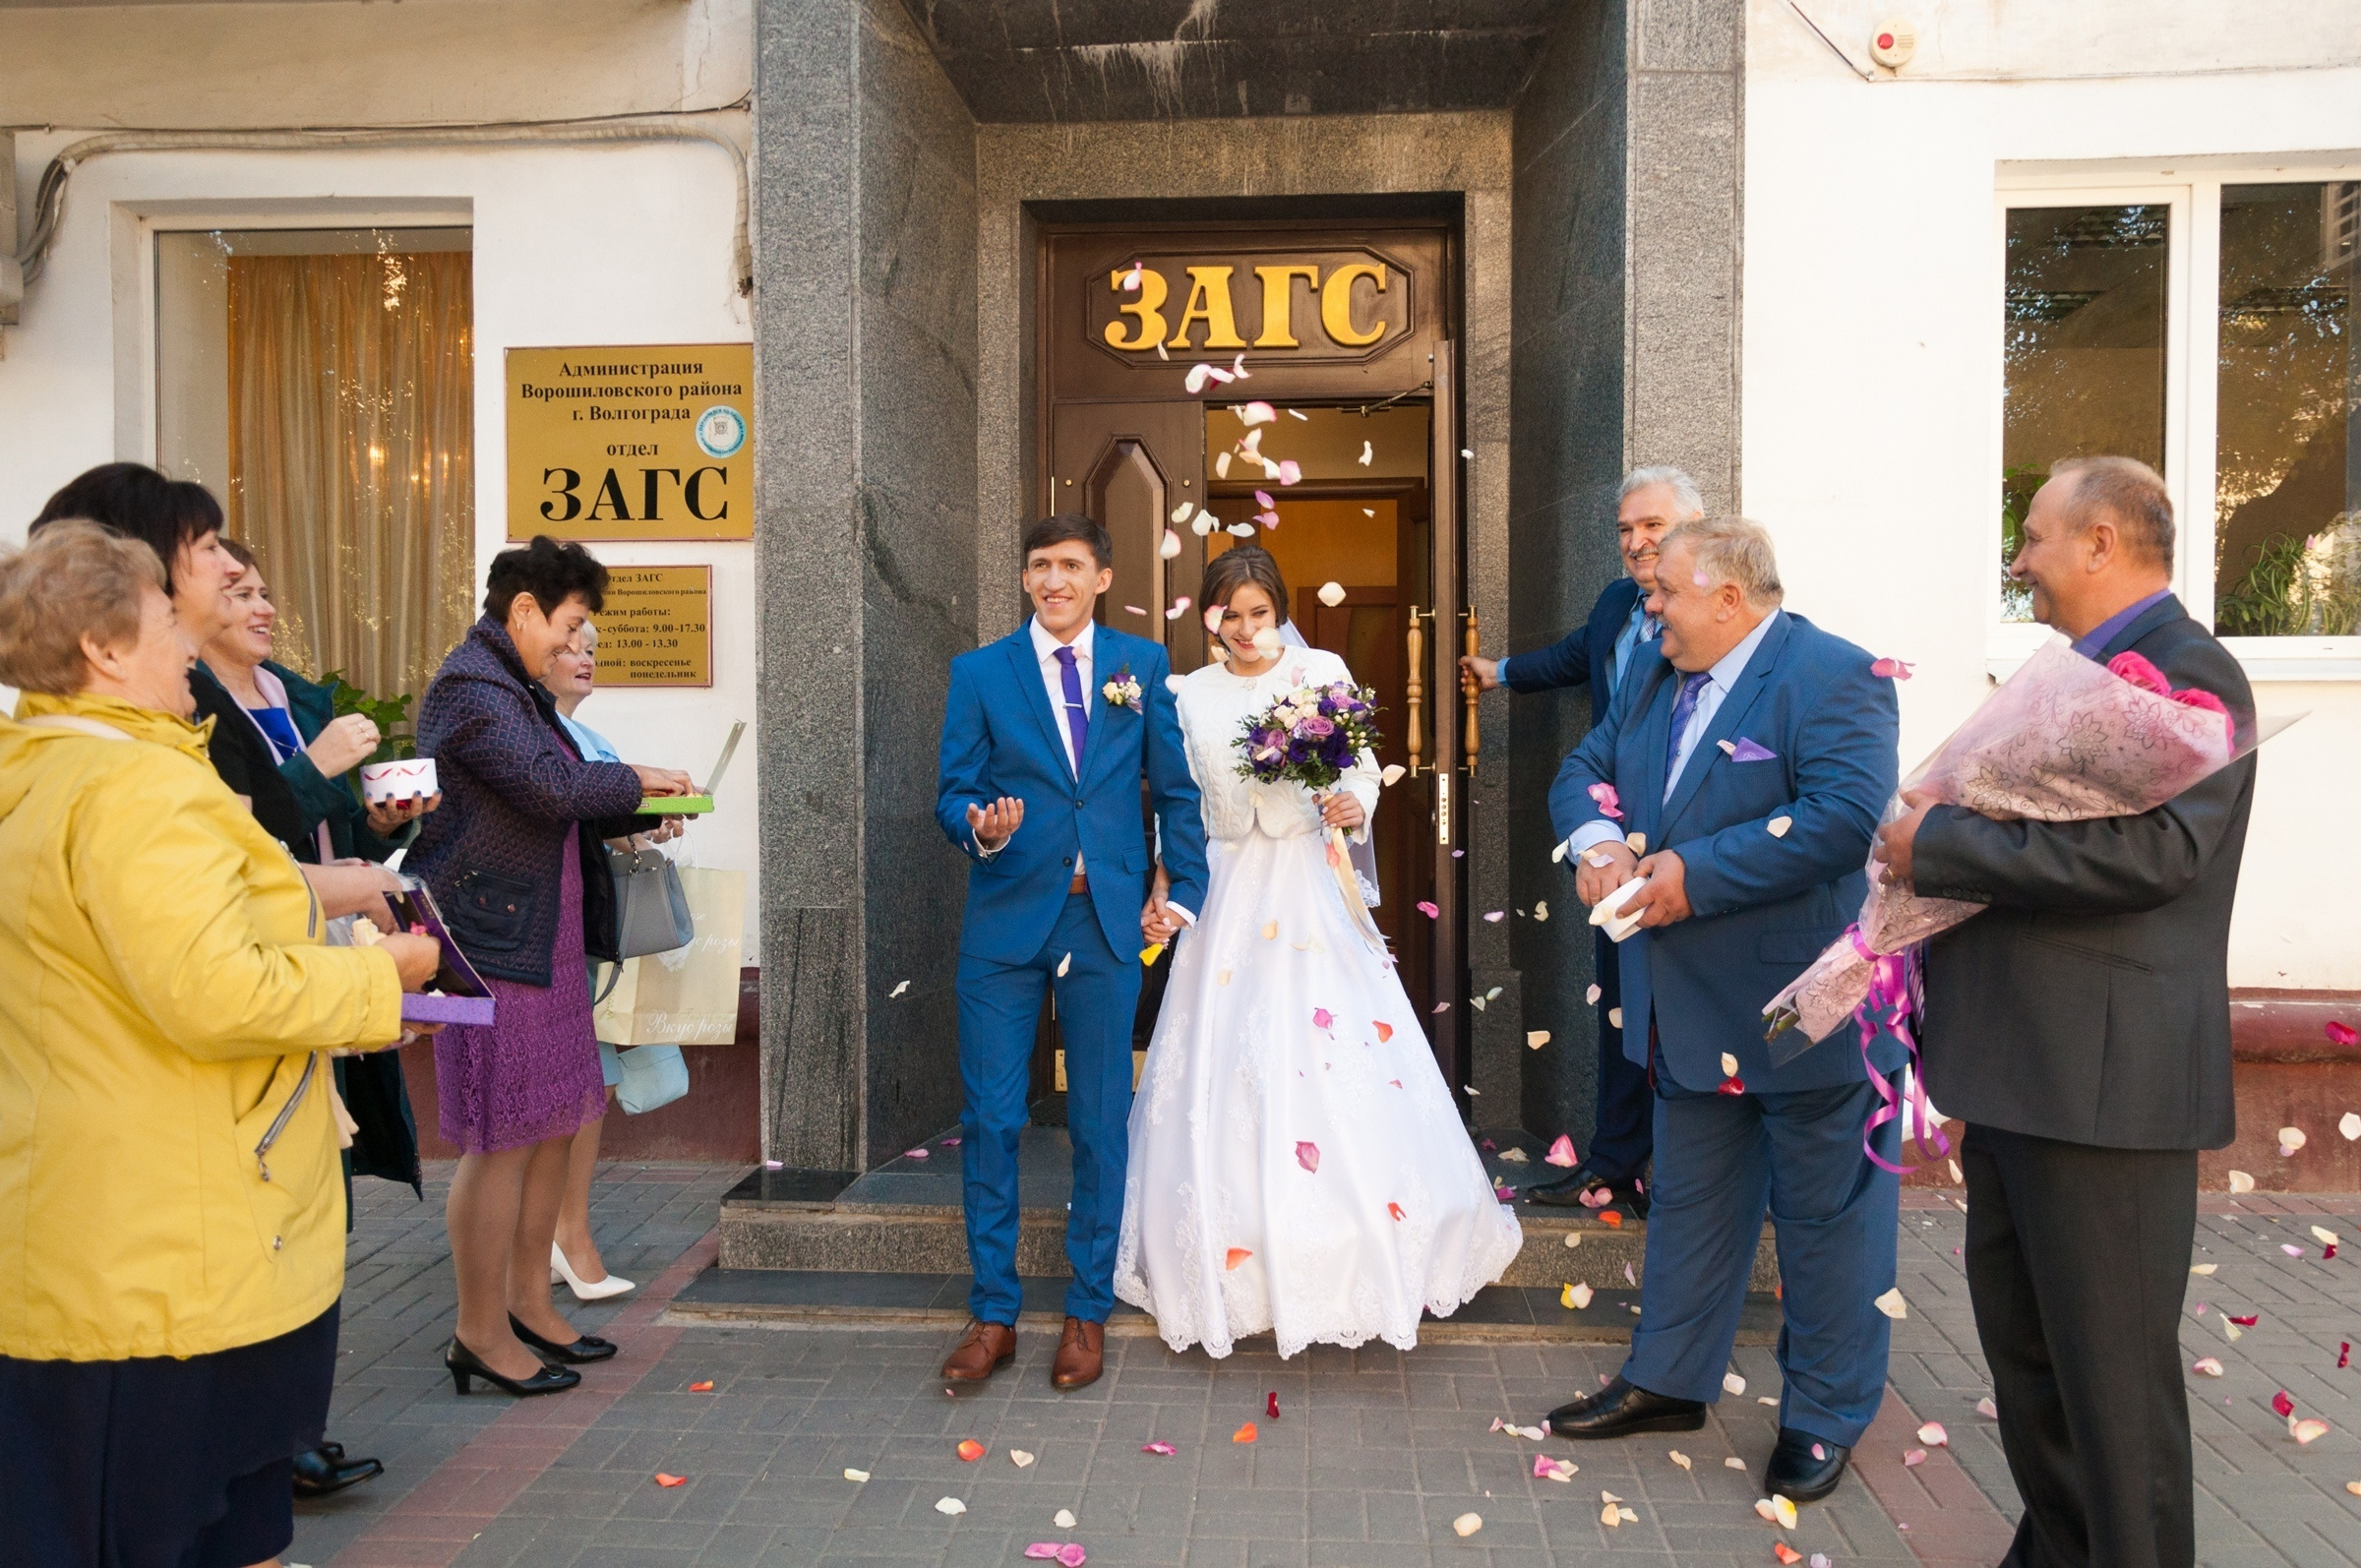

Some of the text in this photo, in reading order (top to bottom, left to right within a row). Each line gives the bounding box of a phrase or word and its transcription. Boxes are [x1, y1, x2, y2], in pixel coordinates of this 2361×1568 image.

[1104, 263, 1386, 351] ЗАГС
[559, 362, 703, 379] Администрация
[521, 381, 743, 402] Ворошиловского района
[573, 405, 691, 423] г. Волгограда
[606, 443, 659, 457] отдел
[540, 466, 728, 521] ЗАГС
[636, 573, 663, 582] ЗАГС
[630, 608, 671, 619] работы:
[617, 639, 642, 648] 13.00
[652, 638, 679, 648] 13.30
[630, 659, 692, 669] воскресенье
[701, 934, 740, 954] розы
[646, 1008, 733, 1042] Вкус розы
